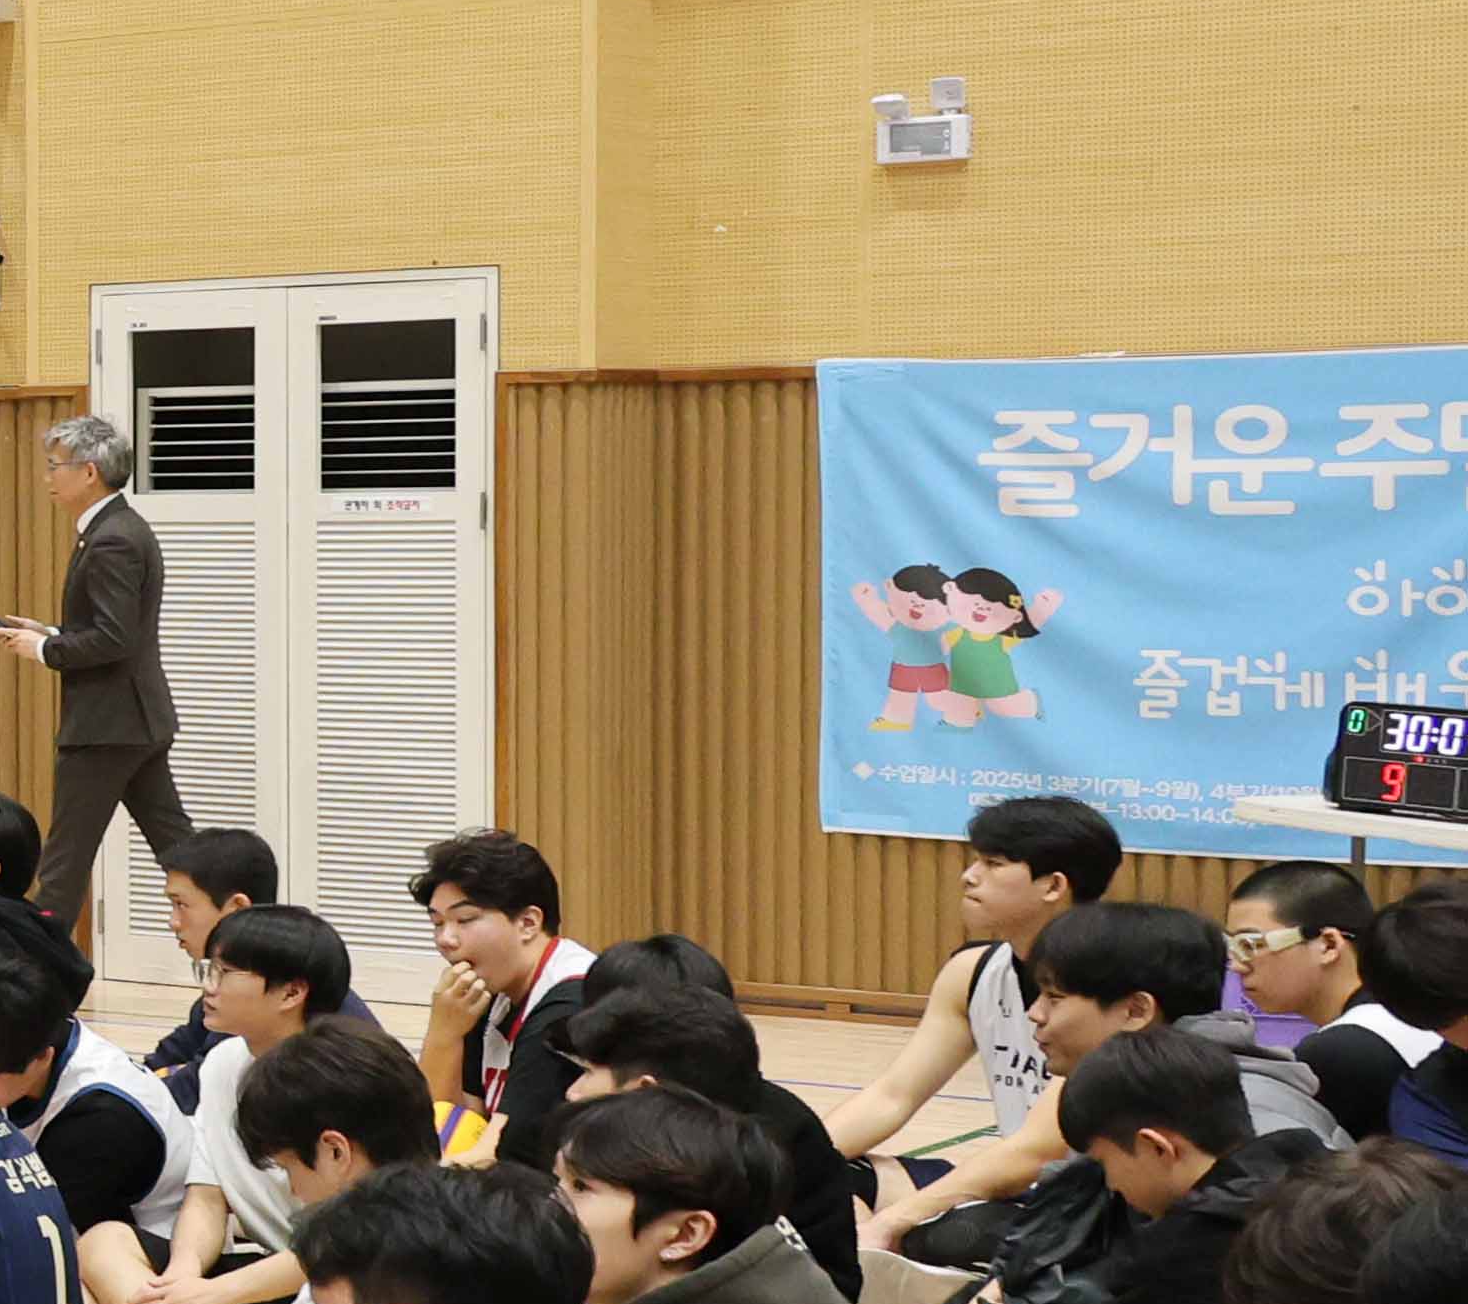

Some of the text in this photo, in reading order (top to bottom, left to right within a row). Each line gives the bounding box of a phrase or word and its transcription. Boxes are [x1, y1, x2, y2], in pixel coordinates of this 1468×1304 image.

[977, 403, 1315, 518] 즐거운
[1133, 649, 1326, 719] 즐겁게
[877, 765, 957, 785] 수업일시
[971, 769, 1043, 792] 2025년
[1380, 762, 1405, 802] 9
